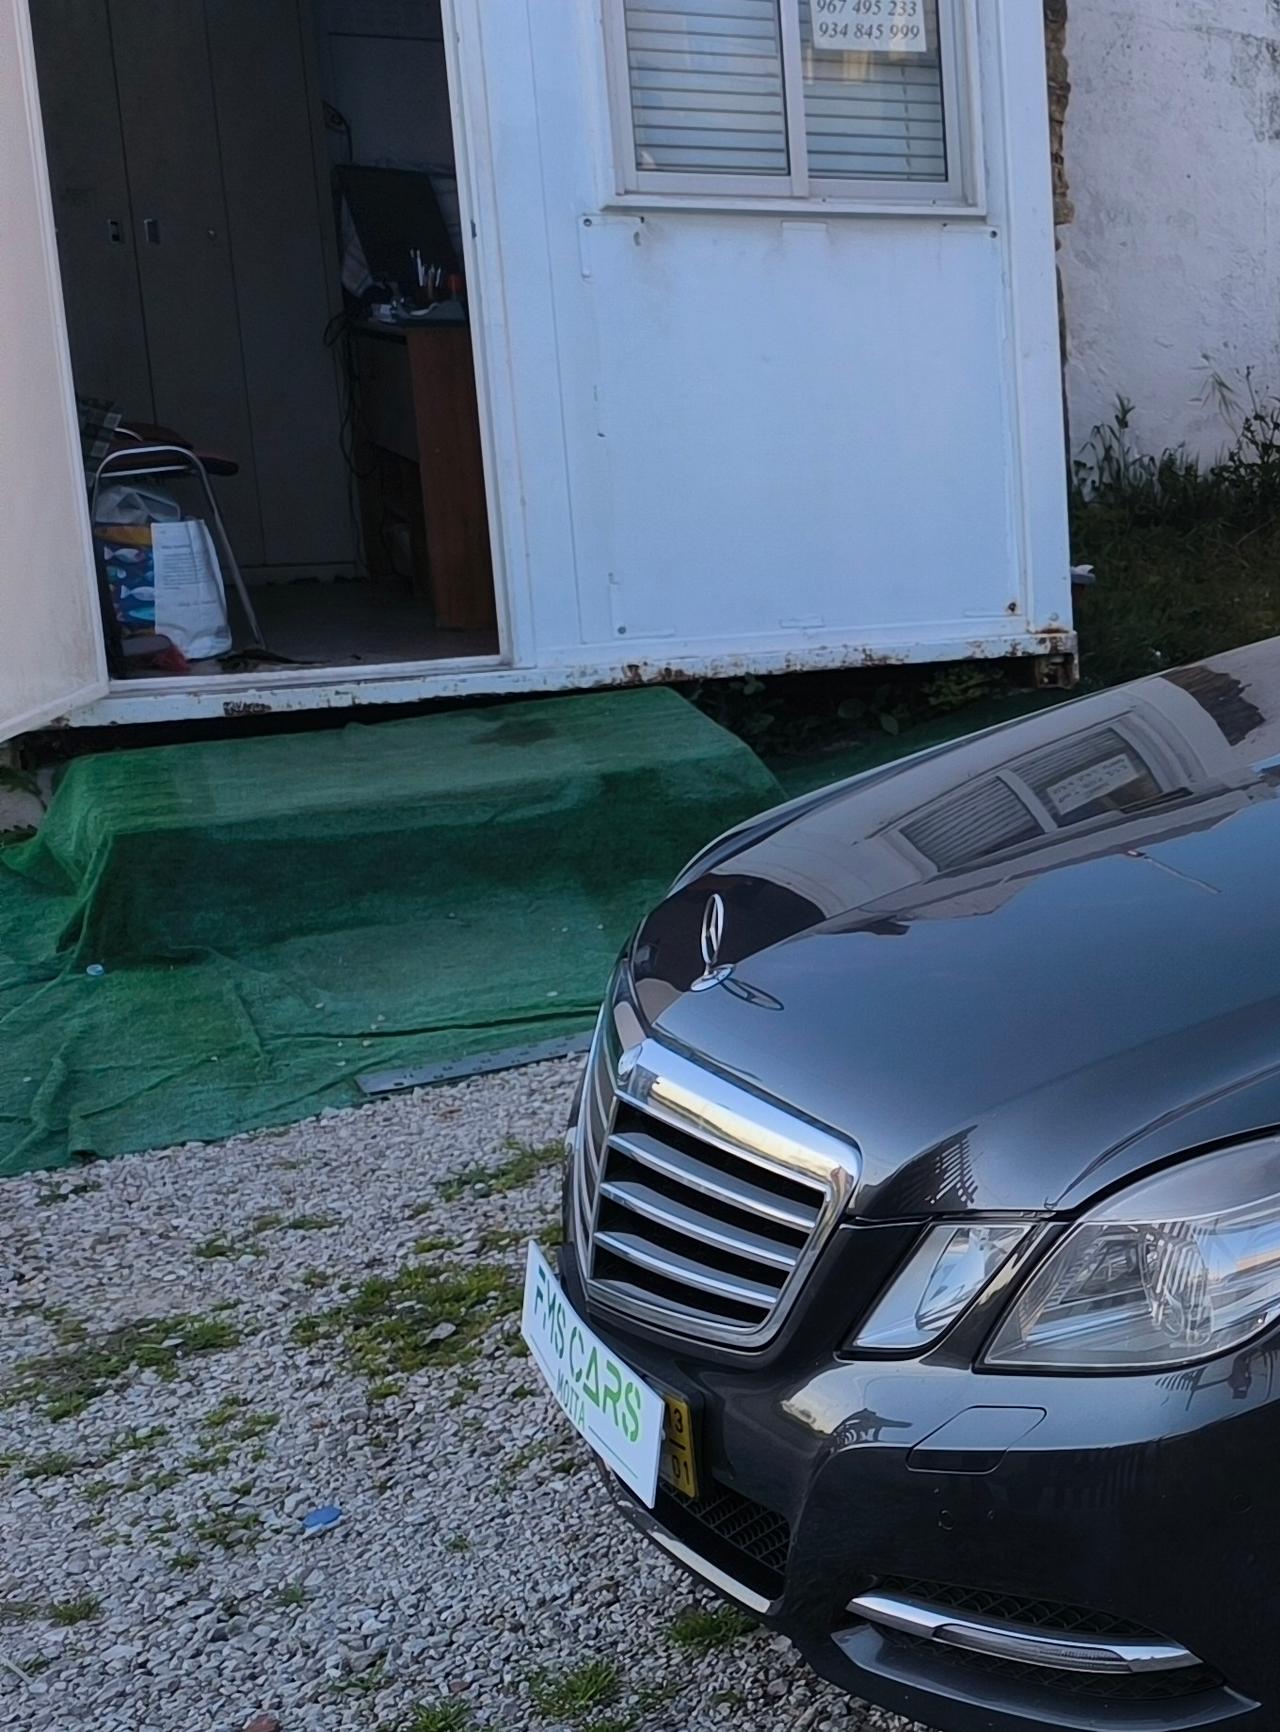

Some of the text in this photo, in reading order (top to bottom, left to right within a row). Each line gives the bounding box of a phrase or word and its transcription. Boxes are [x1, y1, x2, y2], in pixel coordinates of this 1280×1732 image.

[817, 0, 917, 16] 967 495 233
[819, 22, 920, 40] 934 845 999
[534, 1265, 641, 1442] FMS CARS
[556, 1368, 585, 1431] MOITA
